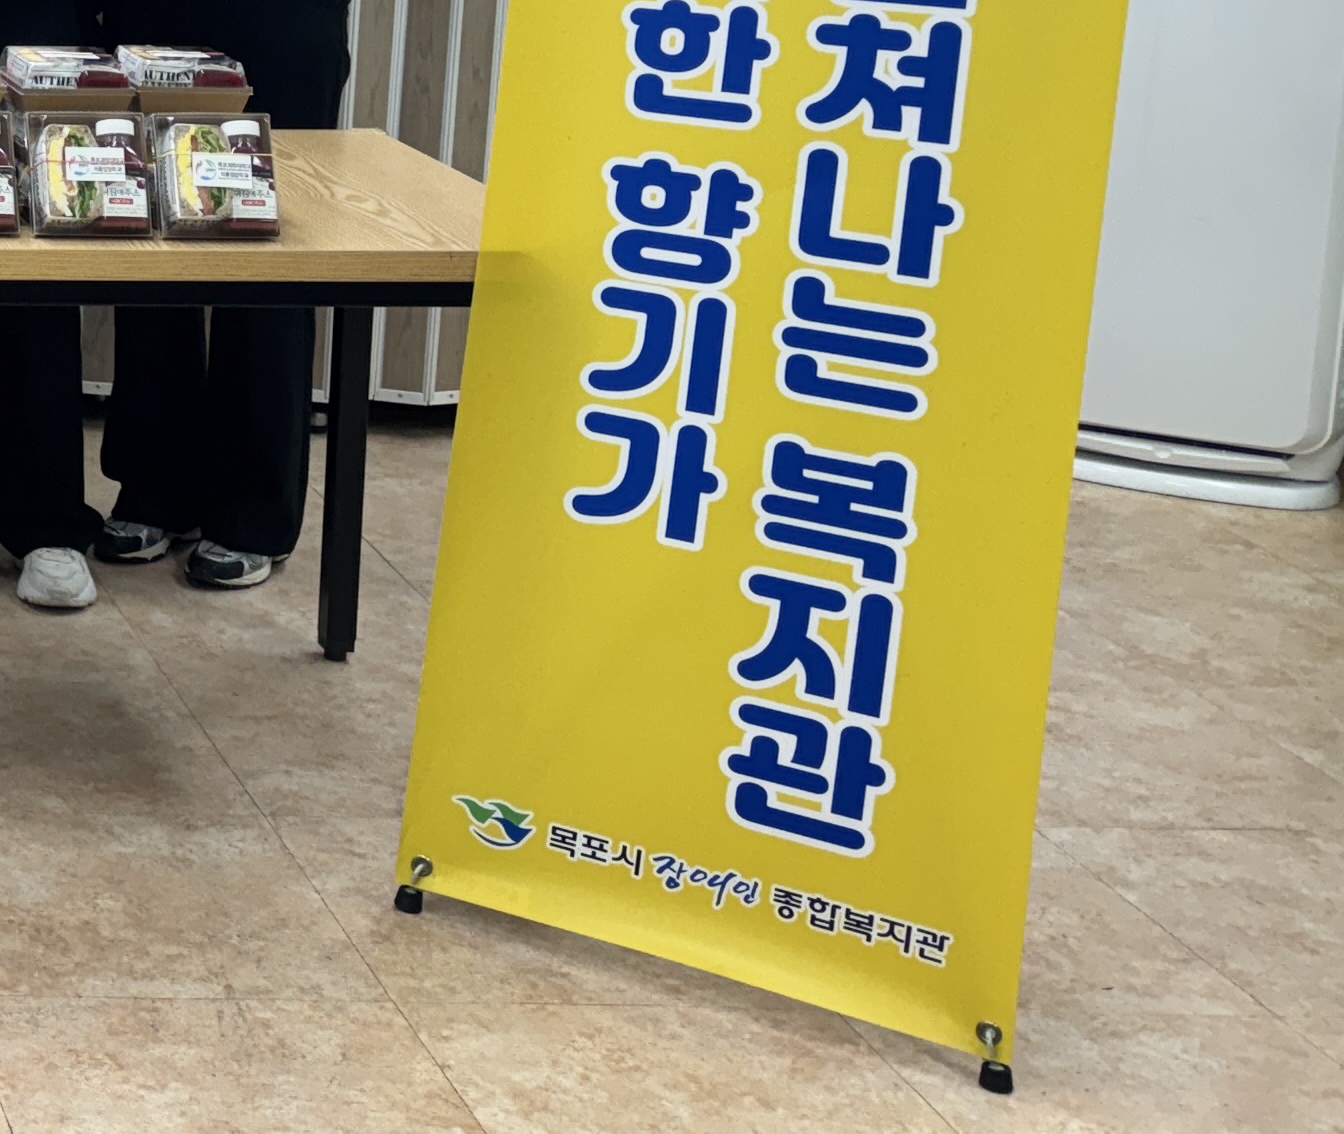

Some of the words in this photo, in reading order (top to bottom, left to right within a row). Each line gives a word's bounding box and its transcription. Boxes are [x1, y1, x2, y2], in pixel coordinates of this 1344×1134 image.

[571, 158, 755, 544] 향기가
[726, 440, 916, 851] 복지관
[548, 824, 644, 877] 목포시
[655, 854, 761, 909] 장애인
[772, 886, 952, 965] 종합복지관
